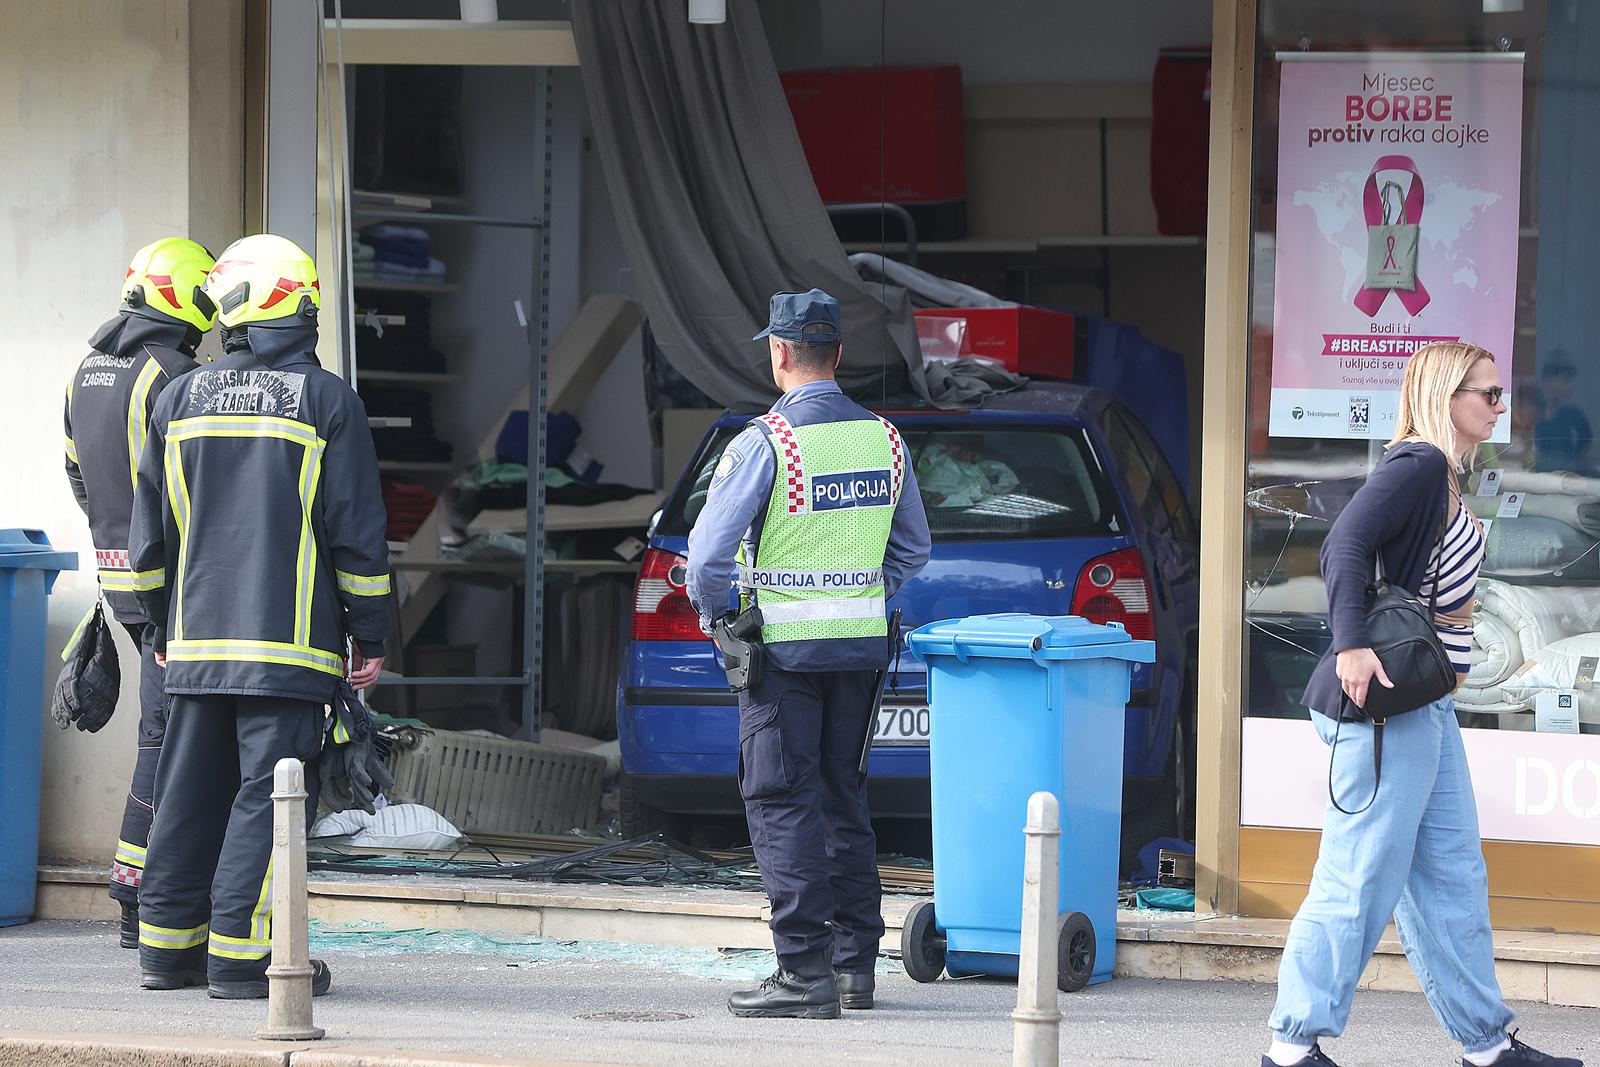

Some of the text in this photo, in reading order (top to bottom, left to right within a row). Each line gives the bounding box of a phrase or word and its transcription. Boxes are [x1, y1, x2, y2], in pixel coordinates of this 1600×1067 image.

[1363, 73, 1434, 96] Mjesec
[1345, 95, 1453, 121] BORBE
[1308, 123, 1490, 148] protiv raka dojke
[1370, 323, 1395, 333] Budi
[1403, 323, 1411, 334] ti
[1330, 339, 1432, 354] #BREASTFRI
[1345, 358, 1380, 371] uključi
[1382, 360, 1394, 369] se
[1397, 361, 1404, 370] u
[82, 372, 116, 387] ZAGREB
[221, 391, 264, 412] ZAGRE
[815, 479, 889, 502] POLICIJA
[753, 572, 815, 587] POLICIJA
[823, 571, 877, 587] POLICIJA
